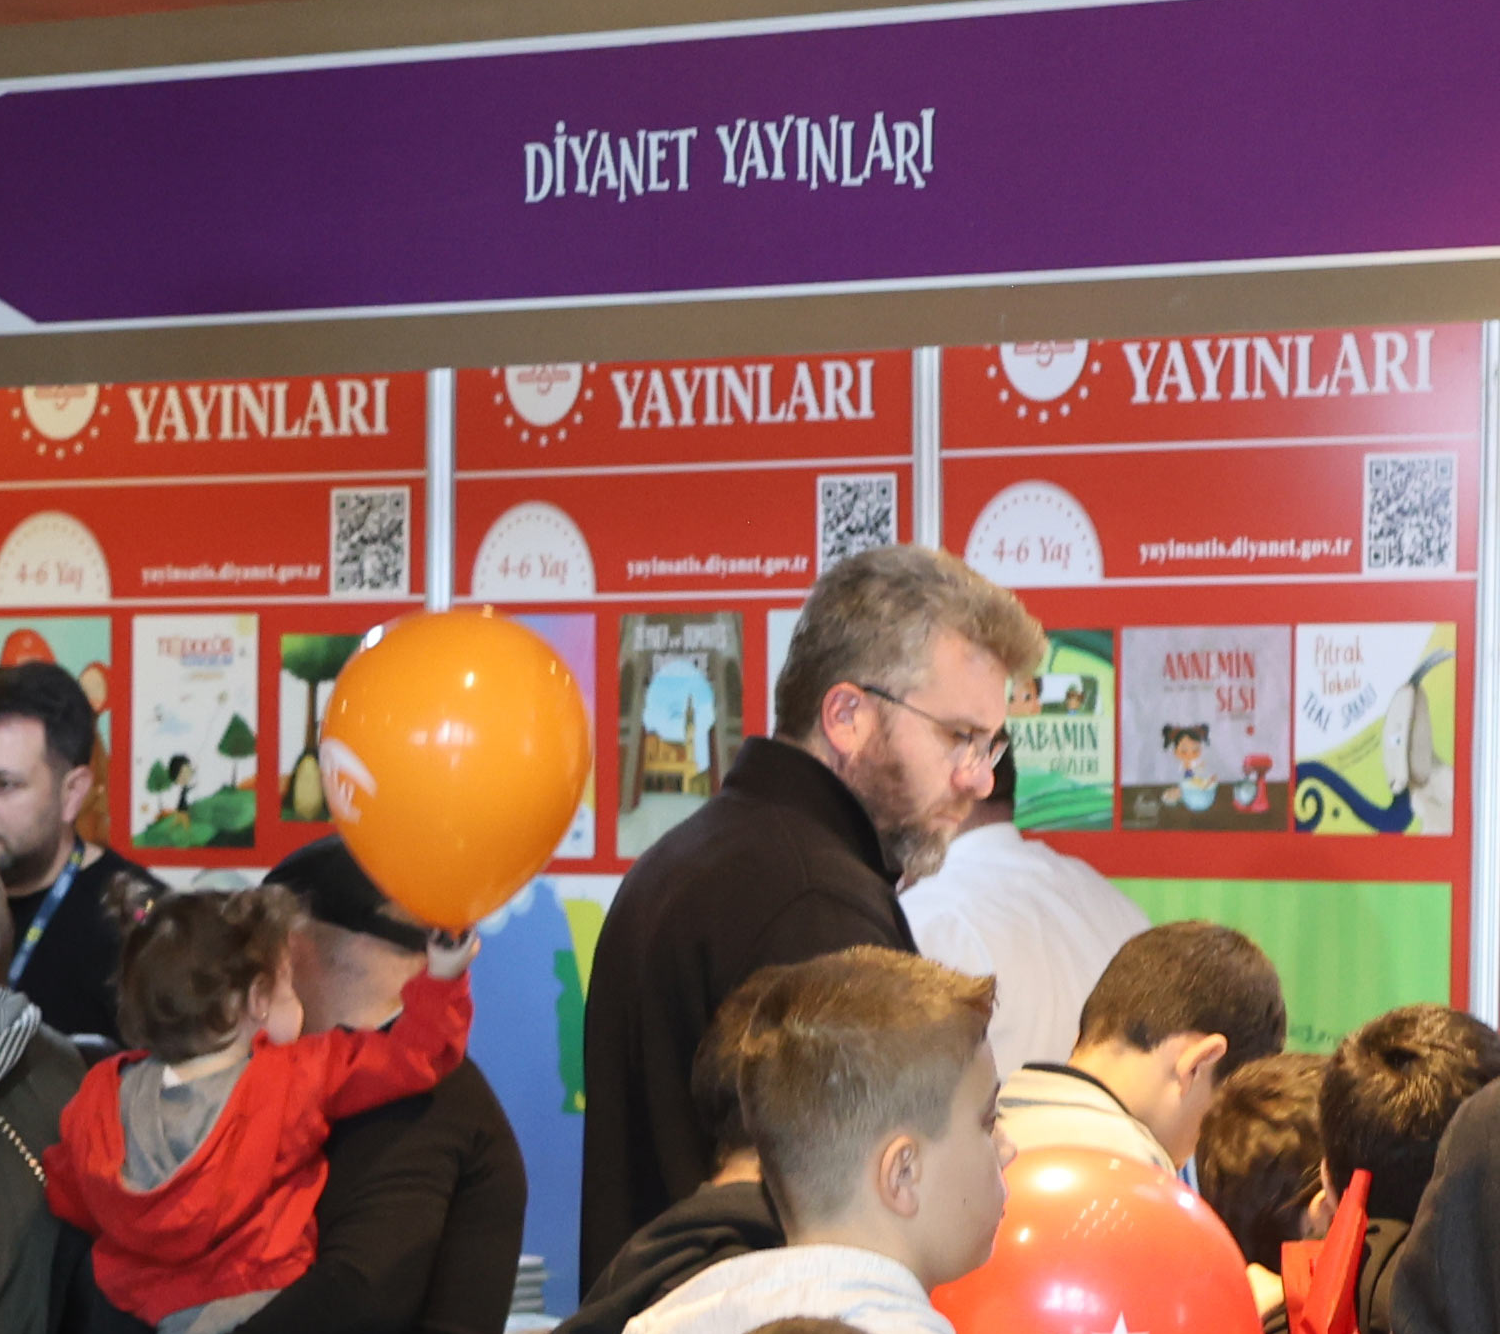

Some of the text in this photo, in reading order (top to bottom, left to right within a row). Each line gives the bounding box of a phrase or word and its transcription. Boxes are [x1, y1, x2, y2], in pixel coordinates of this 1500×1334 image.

[524, 108, 934, 203] DİYANET YAYINLARI
[611, 359, 875, 429] YAYINLARI
[1123, 331, 1434, 404] YAYINLARI
[128, 378, 389, 443] YAYINLARI
[498, 554, 531, 579] 4-6
[992, 537, 1072, 570] 4-6 Yaş
